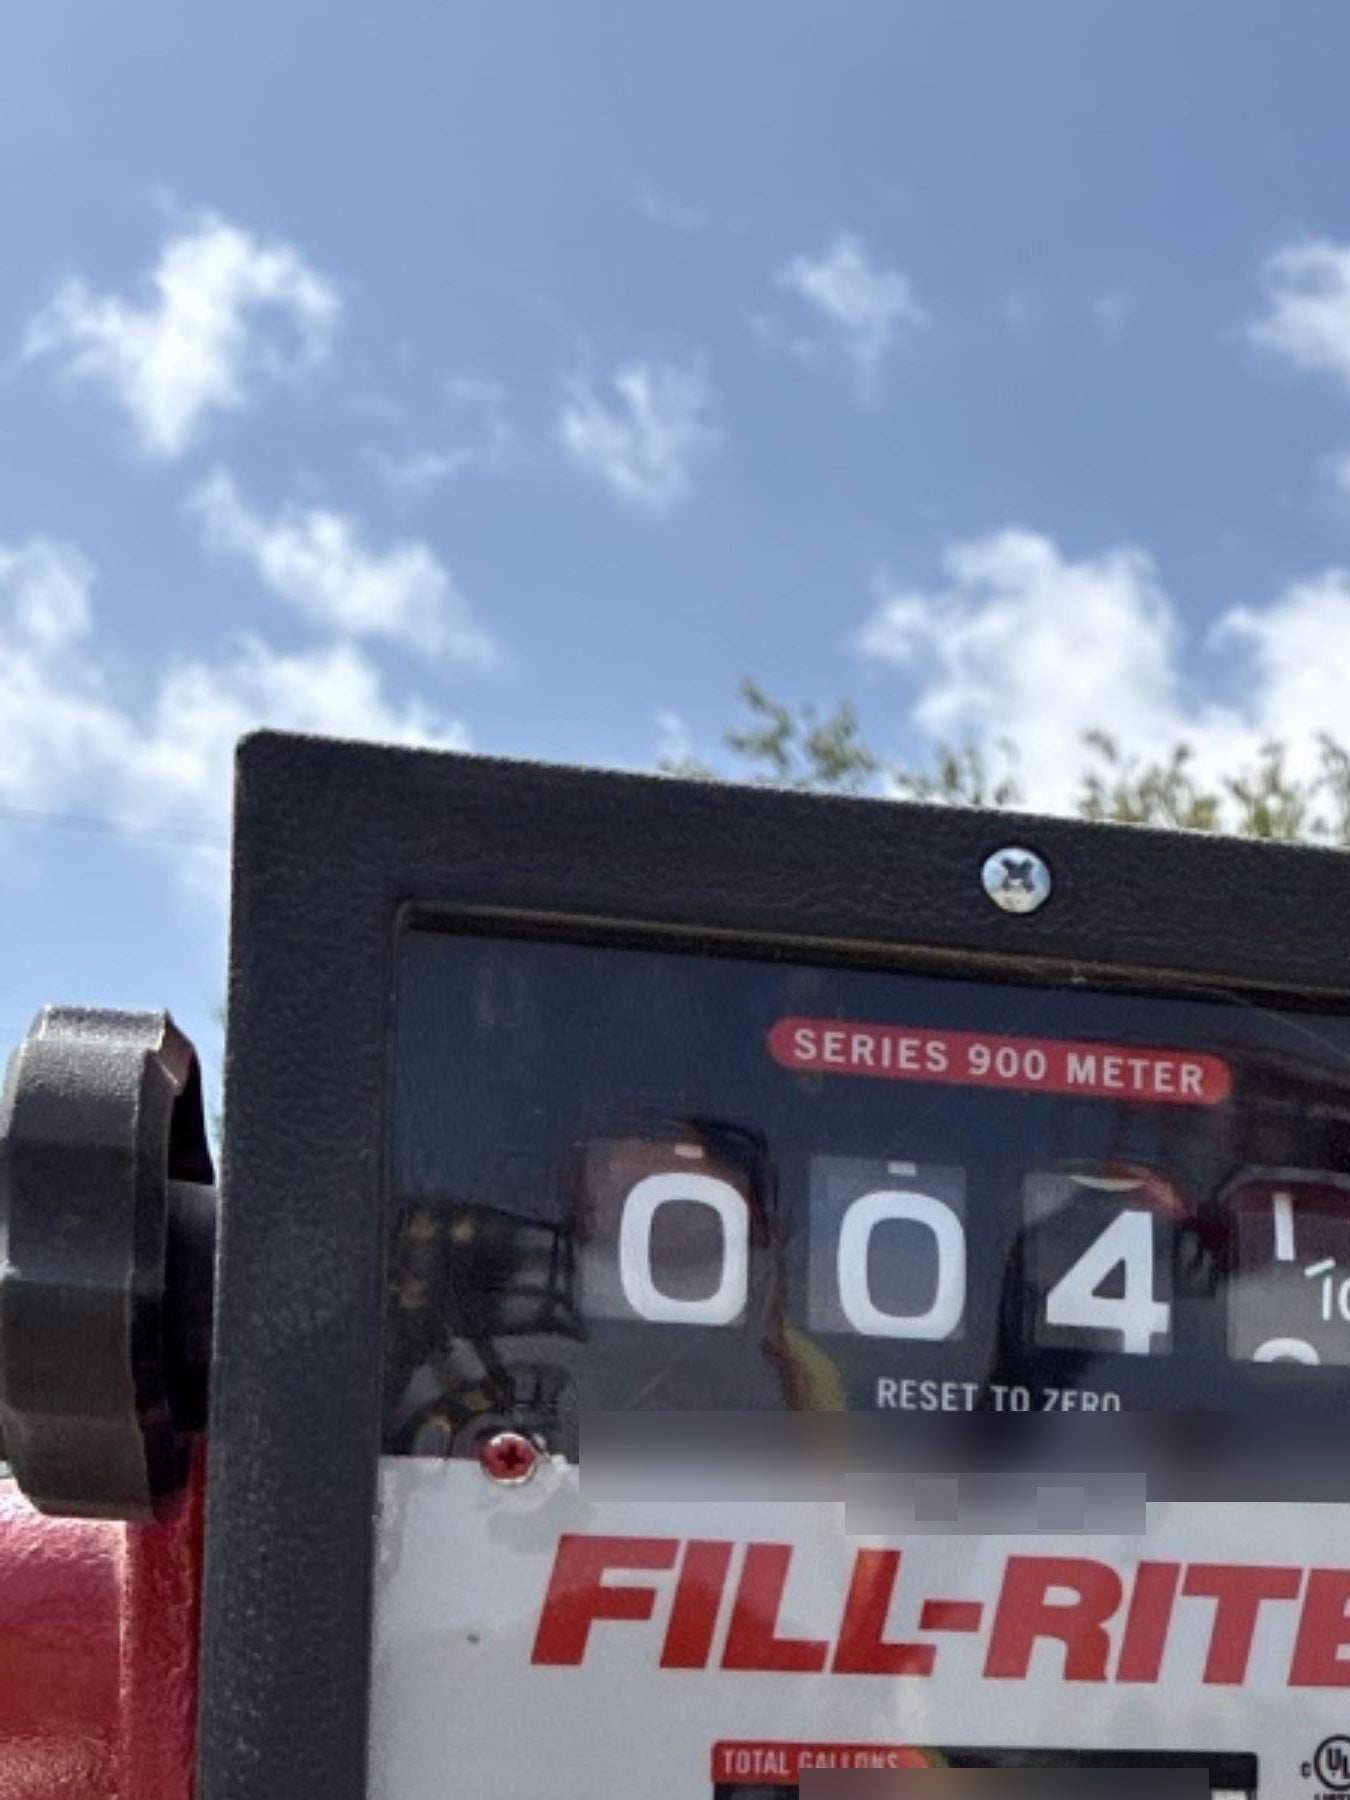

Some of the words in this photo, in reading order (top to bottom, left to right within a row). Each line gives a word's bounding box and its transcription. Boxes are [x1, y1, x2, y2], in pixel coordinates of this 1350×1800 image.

[792, 1028, 949, 1073] SERIES
[967, 1043, 1046, 1082] 900
[1066, 1051, 1204, 1096] METER
[877, 1377, 979, 1412] RESET
[990, 1385, 1030, 1412] TO
[723, 1748, 791, 1775] TOTAL
